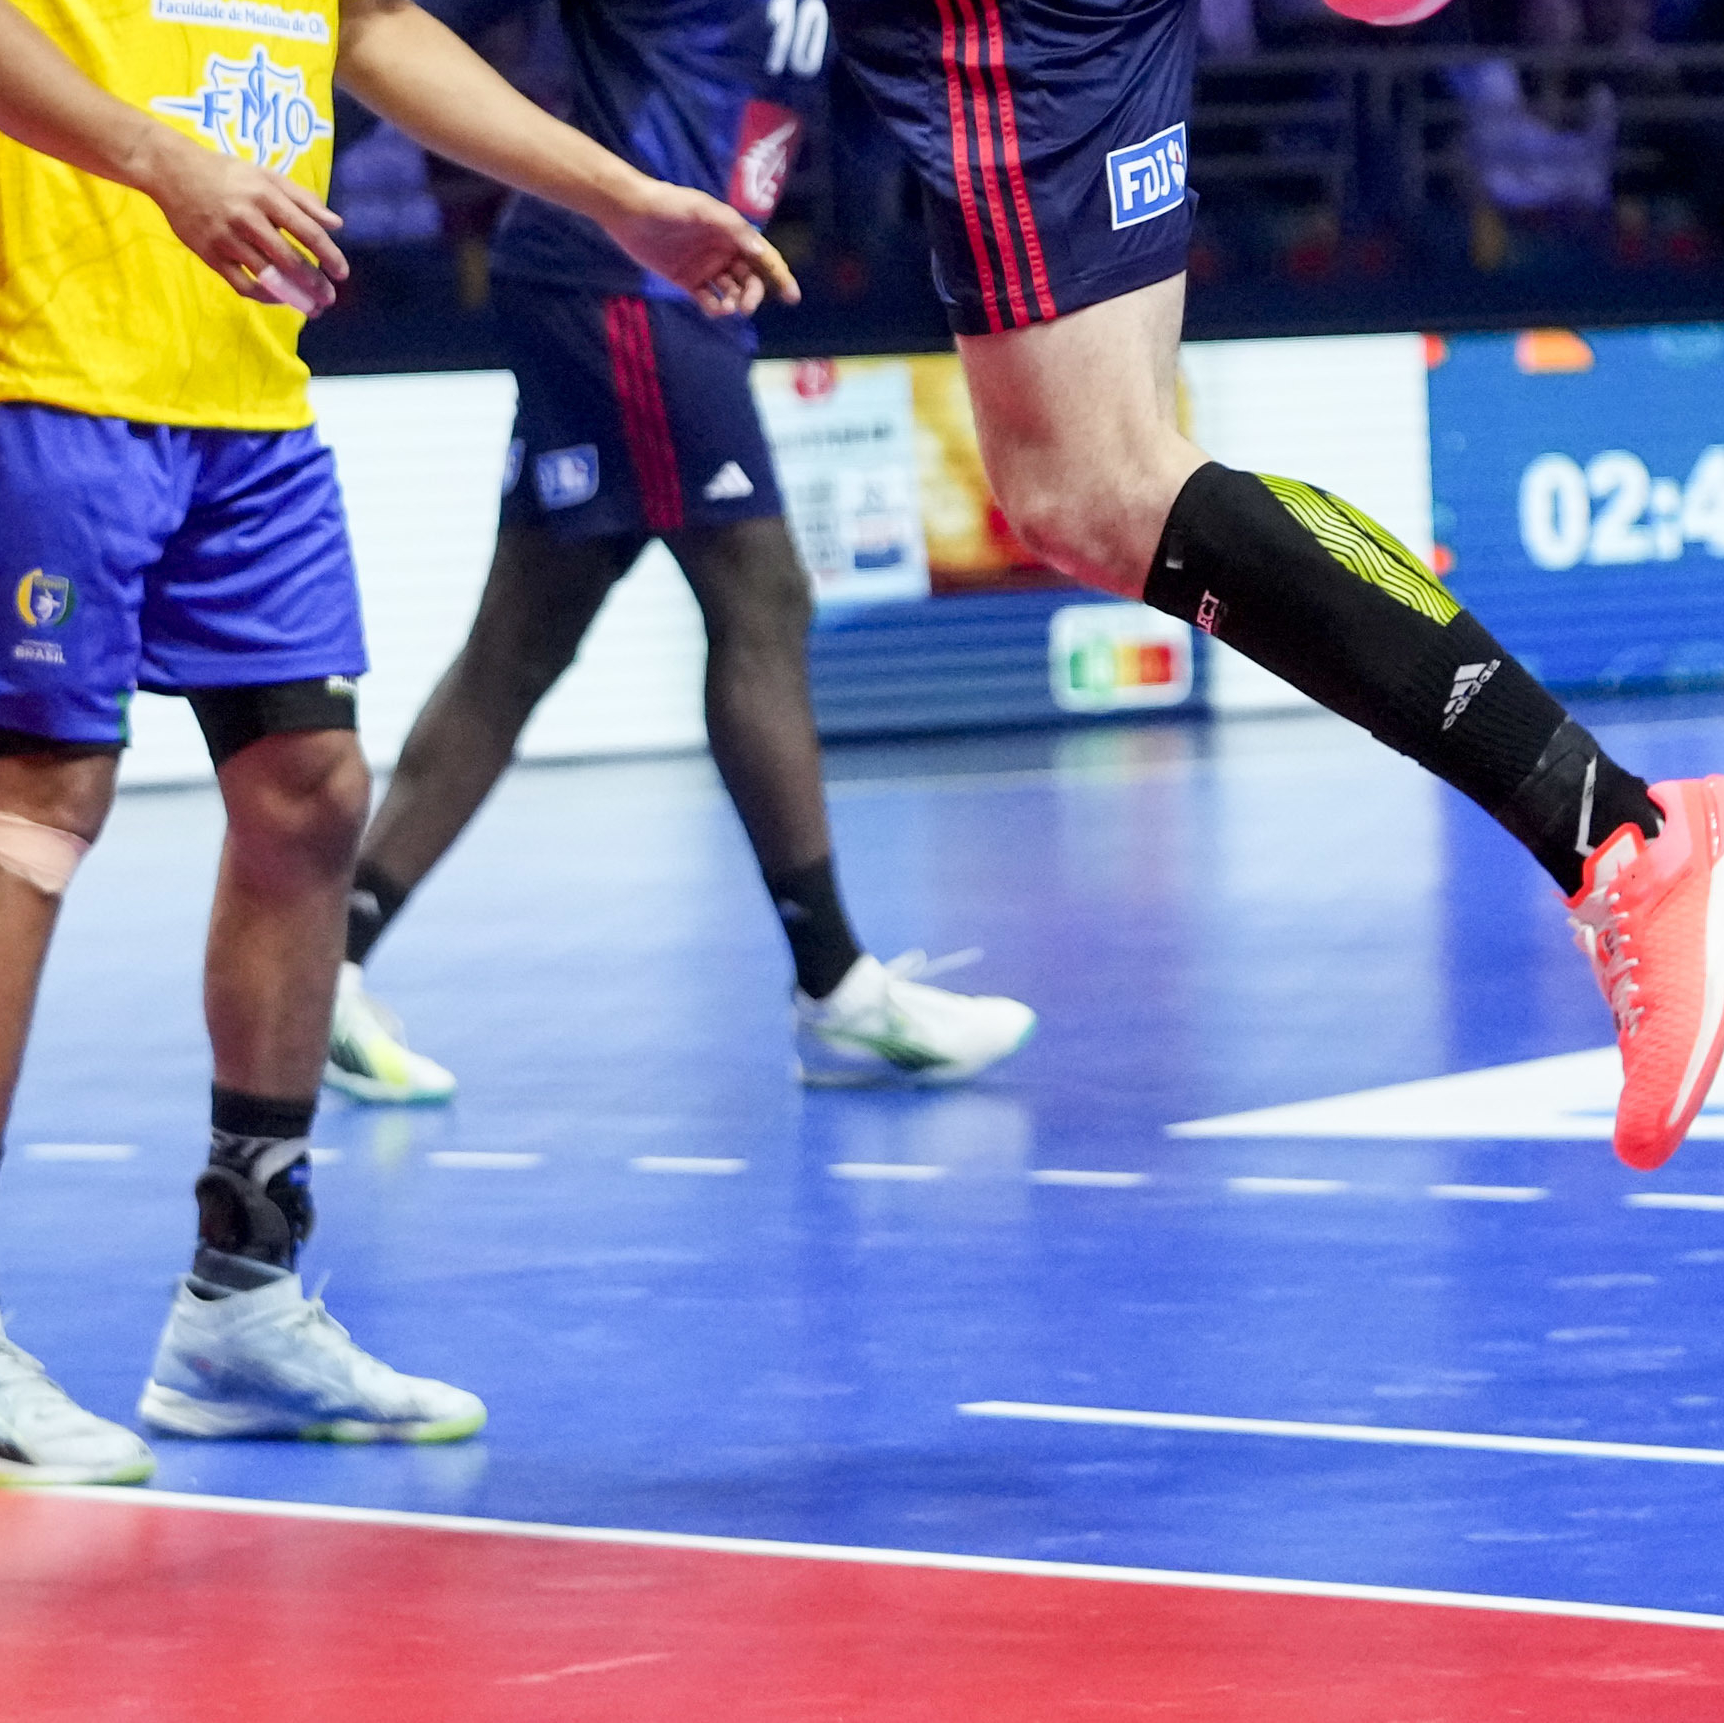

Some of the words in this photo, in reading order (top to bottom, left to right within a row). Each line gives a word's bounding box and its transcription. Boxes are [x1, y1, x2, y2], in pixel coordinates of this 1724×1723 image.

[292, 16, 305, 32] de
[1119, 148, 1171, 212] FDJ
[1441, 658, 1502, 732] adidas
